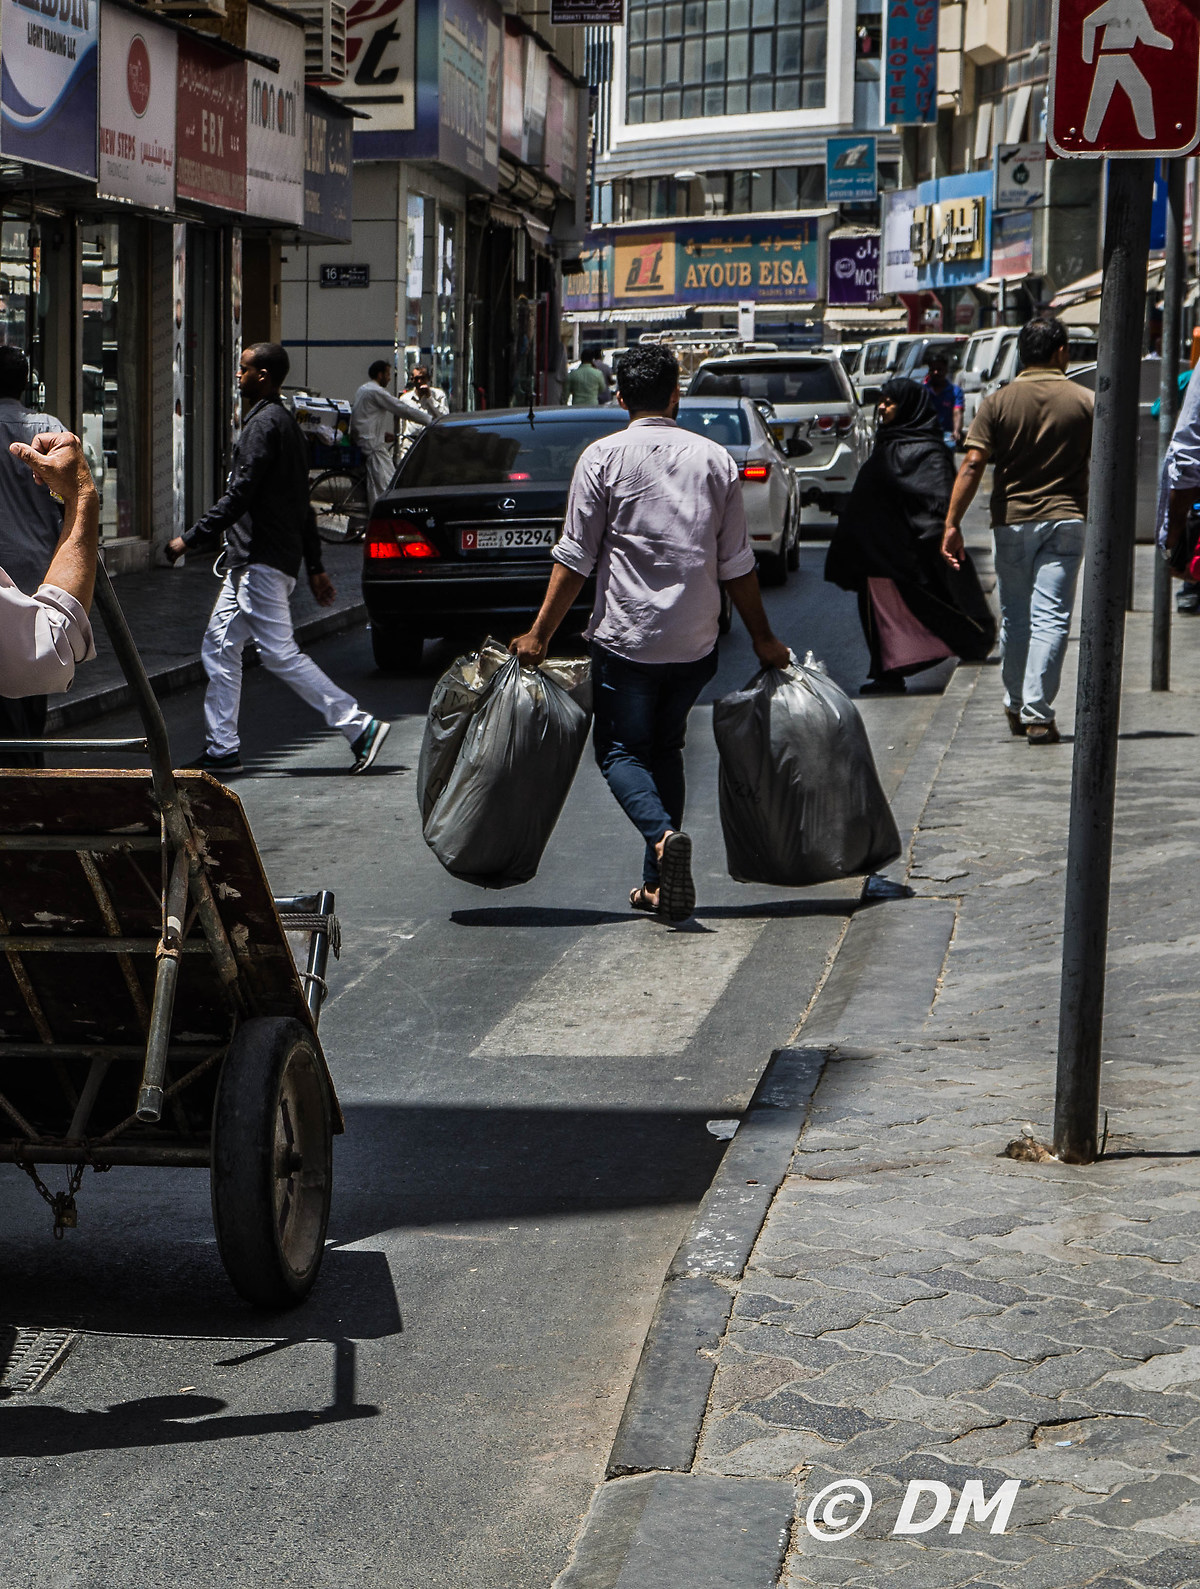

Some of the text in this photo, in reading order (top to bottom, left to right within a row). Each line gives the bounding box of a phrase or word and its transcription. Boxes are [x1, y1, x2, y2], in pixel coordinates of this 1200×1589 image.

[27, 21, 76, 61] LIGHT TRADING LLC
[100, 127, 135, 161] NEW STEPS
[202, 109, 224, 158] EBX
[325, 267, 338, 280] 16
[684, 260, 809, 289] AYOUB EISA
[466, 533, 474, 546] 9
[504, 529, 553, 546] 93294
